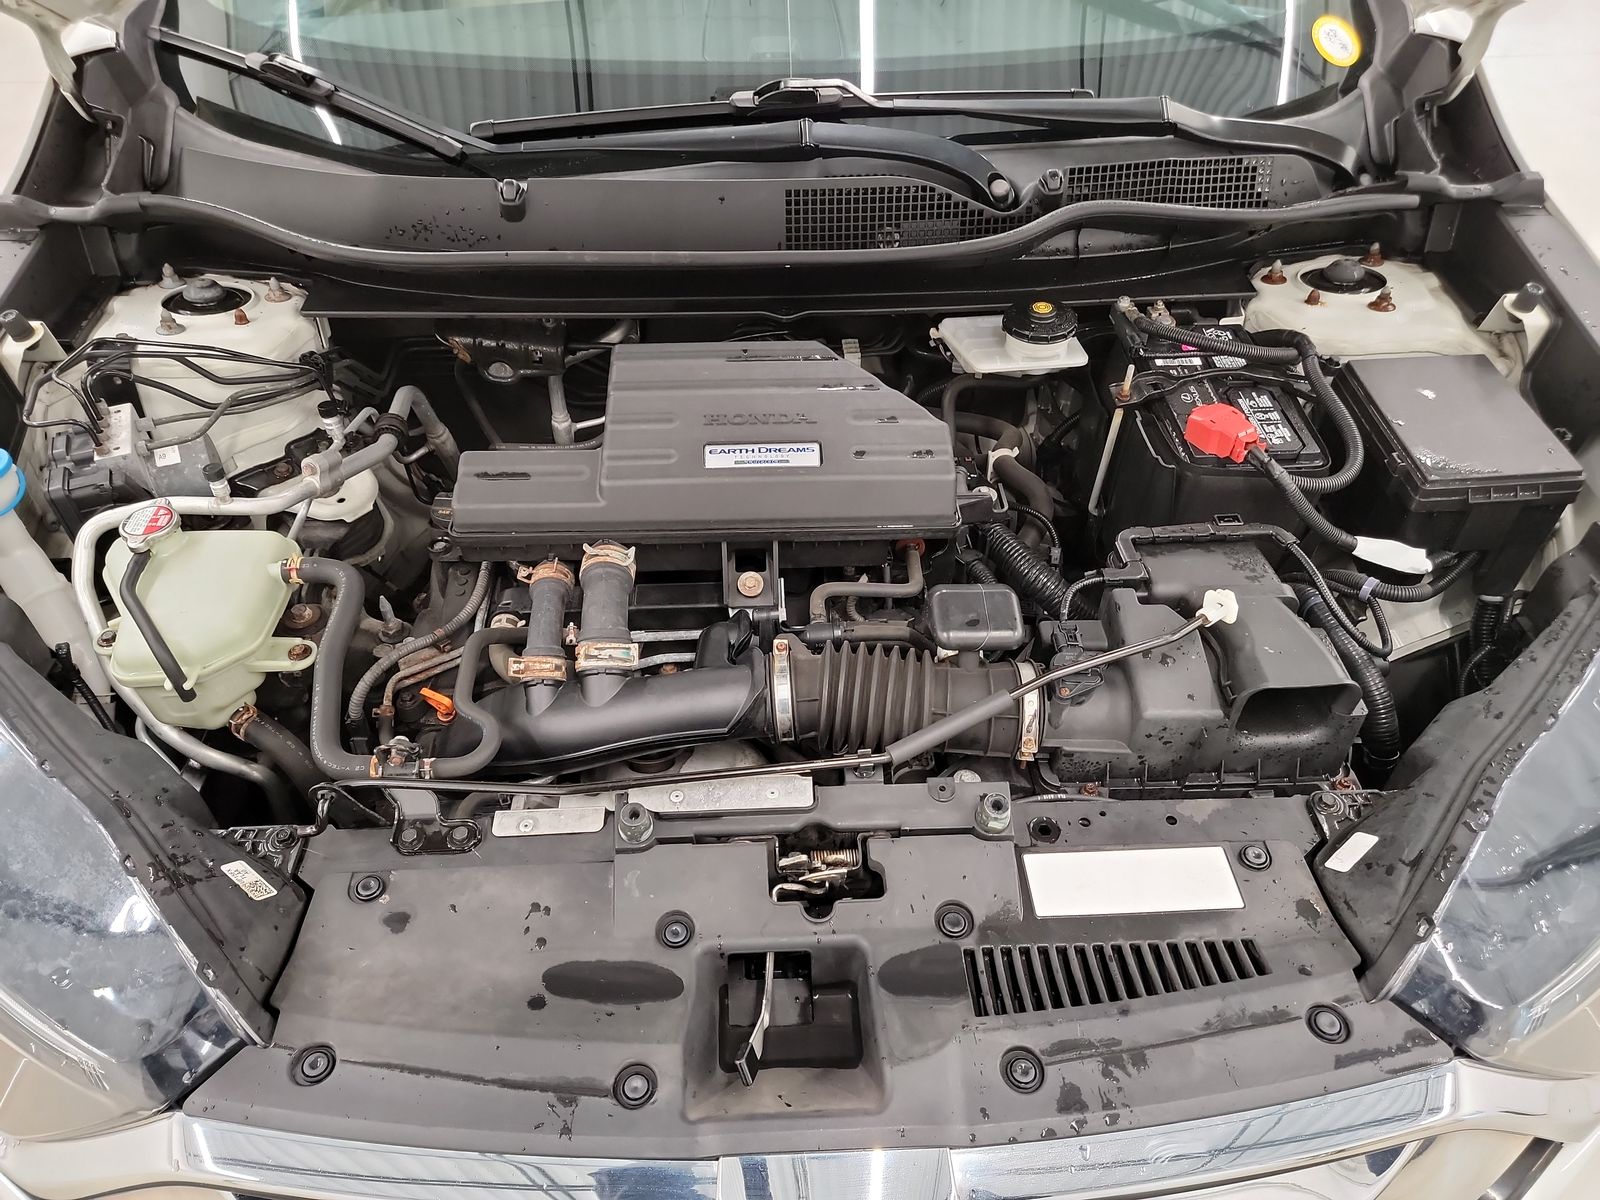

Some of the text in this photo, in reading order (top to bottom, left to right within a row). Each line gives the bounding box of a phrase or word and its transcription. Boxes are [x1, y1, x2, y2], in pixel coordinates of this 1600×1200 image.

[1189, 385, 1203, 406] EXUS
[703, 412, 818, 426] HONDA
[708, 446, 815, 455] EARTH DREAMS
